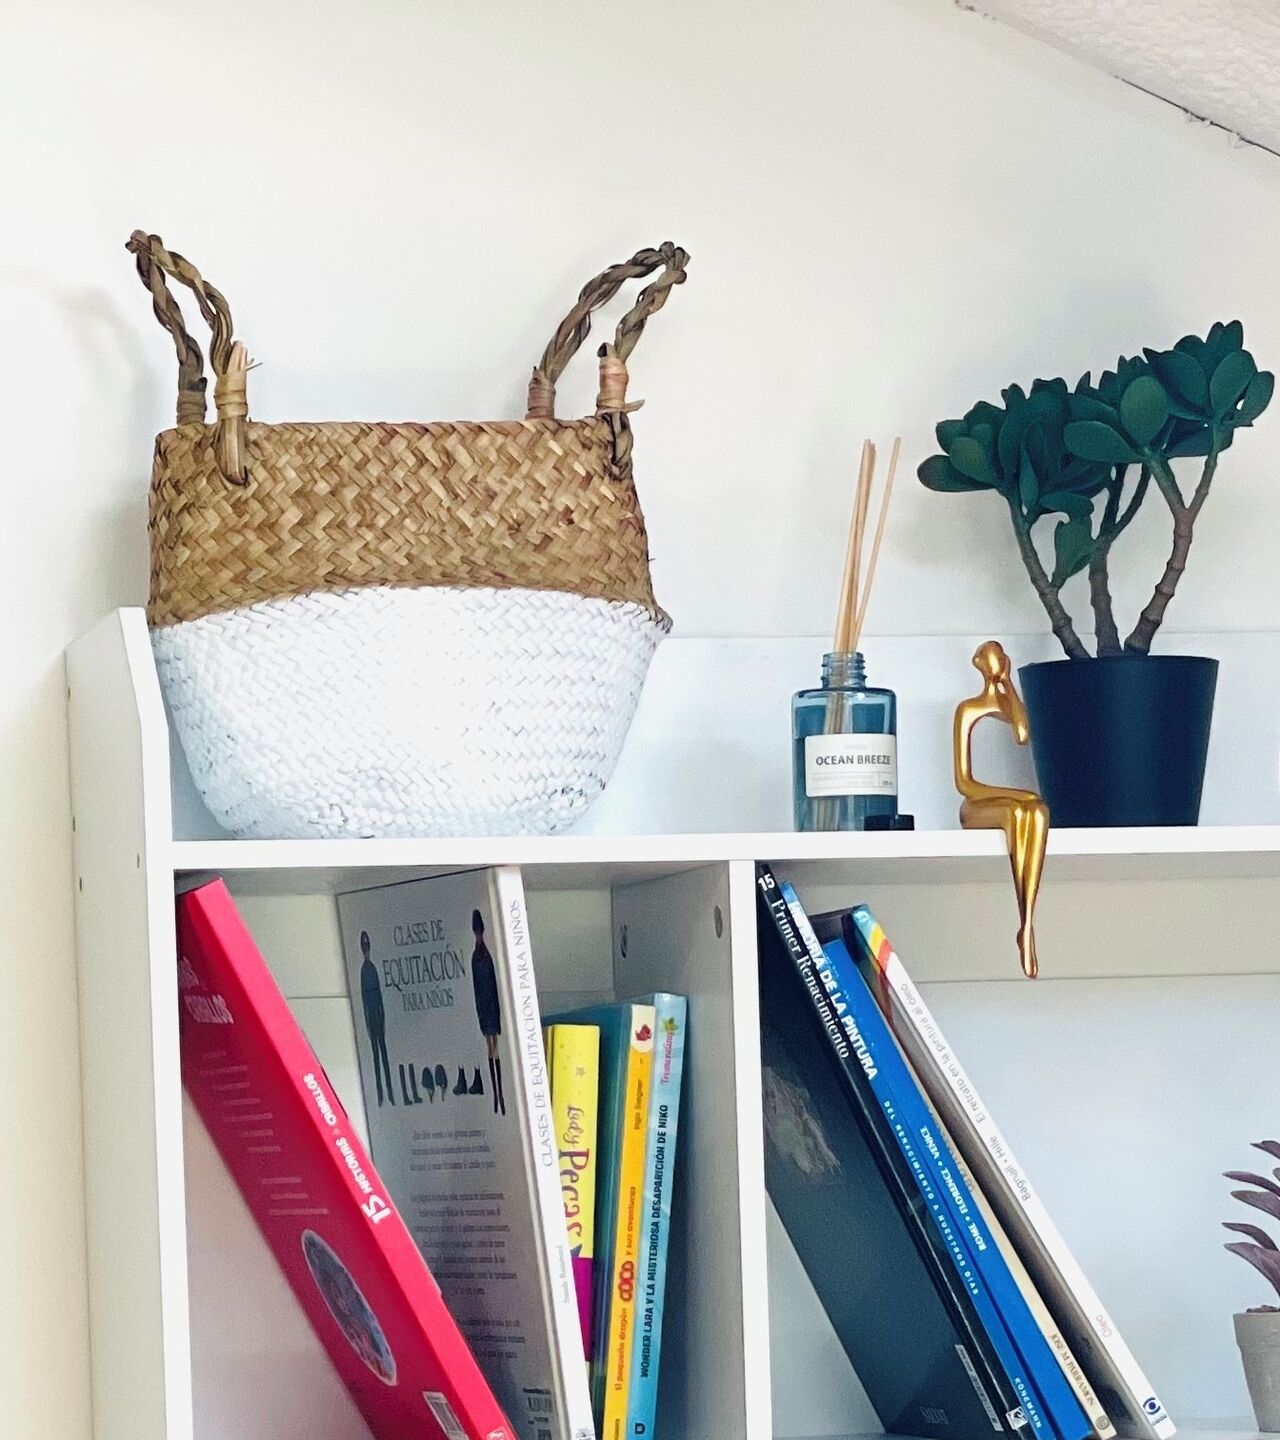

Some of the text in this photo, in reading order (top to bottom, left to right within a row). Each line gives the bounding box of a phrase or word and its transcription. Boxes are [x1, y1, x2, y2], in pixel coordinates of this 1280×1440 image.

[815, 754, 891, 766] OCEAN BREEZE
[758, 873, 776, 892] 15
[393, 919, 445, 946] CLASES DE
[381, 945, 466, 991] EQUITACIÓN
[515, 950, 534, 993] PARA
[771, 898, 851, 1060] Primer Renacimiento
[402, 992, 424, 1012] PARA
[819, 968, 878, 1081] DE LA PINTURA
[899, 982, 986, 1125] El retrato en la pintura al óleo
[534, 1087, 546, 1108] DE
[535, 1111, 553, 1167] CLASES
[562, 1103, 585, 1145] Lady
[919, 1125, 941, 1160] VENICE
[335, 1136, 373, 1193] HISTORIAS
[883, 1099, 896, 1121] DEL
[895, 1124, 935, 1200] RENACIMIENTO
[932, 1203, 940, 1211] A
[937, 1214, 966, 1267] NUESTROS
[989, 1135, 1032, 1202] Bagnall Hille
[361, 1194, 392, 1224] 15
[559, 1148, 590, 1237] Pecas
[939, 1167, 970, 1215] FLORENCE
[640, 1104, 669, 1379] WONDER LARA Y LA MISTERIOSA DESAPARICIÓN DE NIKO
[968, 1222, 989, 1251] ROME
